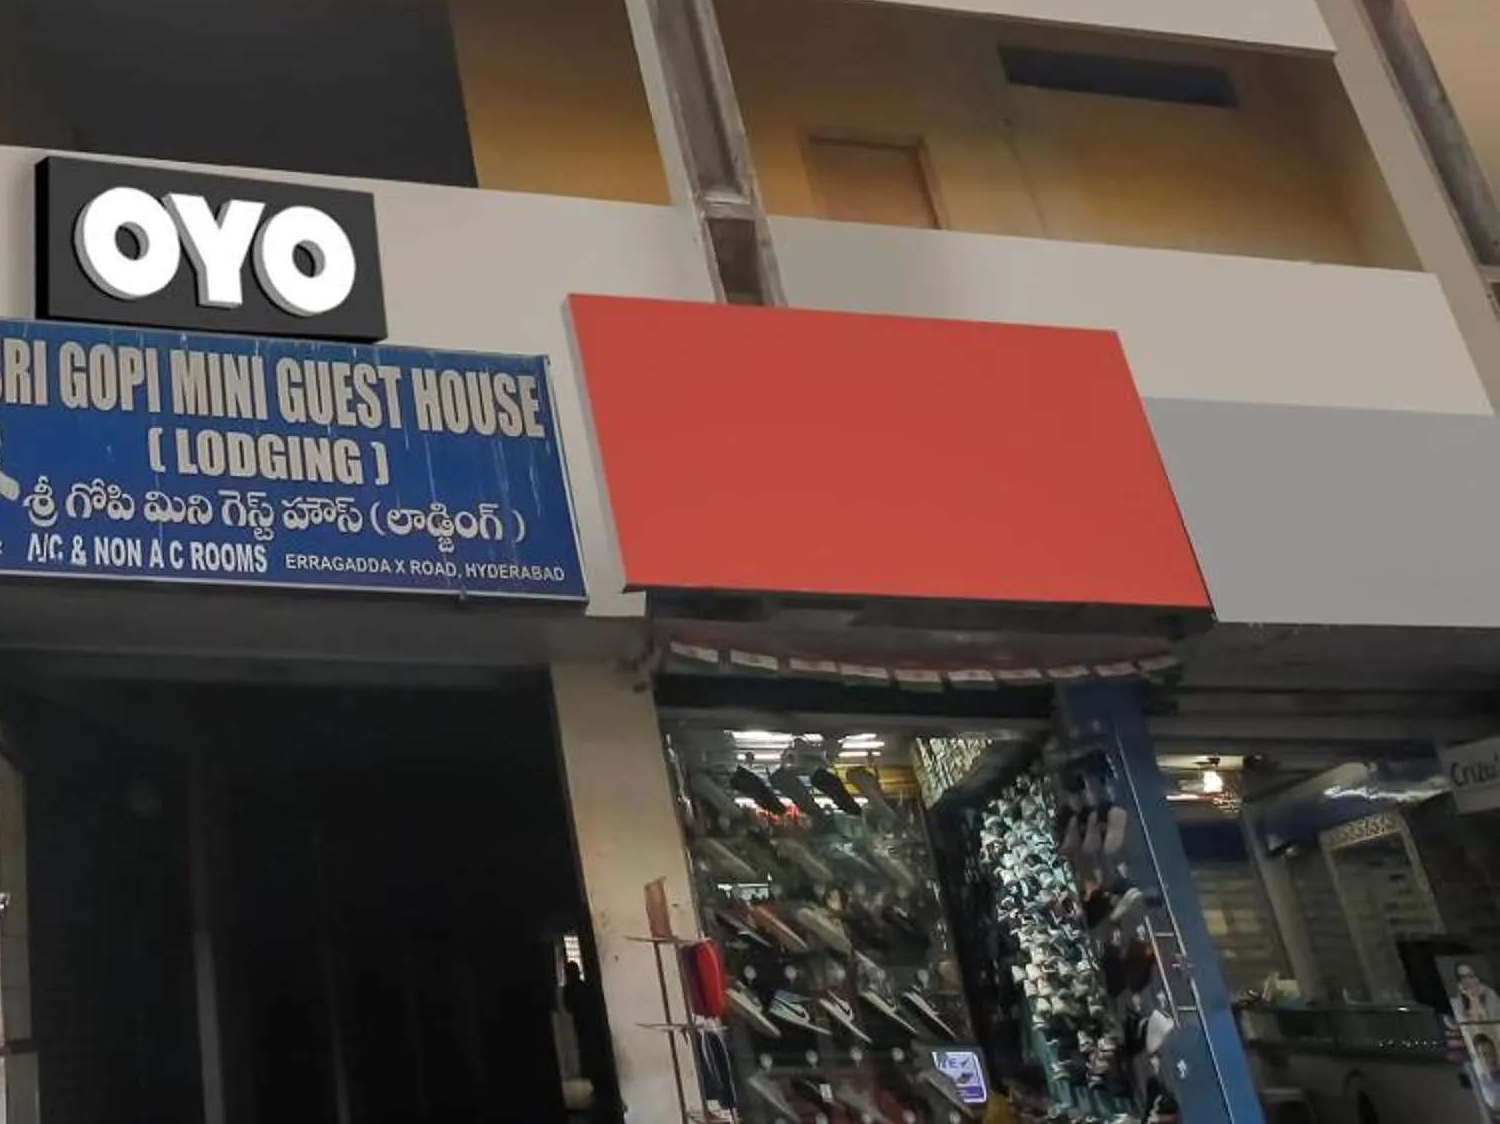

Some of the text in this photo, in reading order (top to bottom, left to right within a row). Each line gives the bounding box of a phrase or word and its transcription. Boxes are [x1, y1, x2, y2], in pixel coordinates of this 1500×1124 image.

[73, 186, 357, 317] OYO
[59, 340, 161, 414] GOPI
[170, 349, 269, 420] MINI
[276, 357, 402, 429] GUEST
[411, 367, 546, 438] HOUSE
[23, 475, 58, 528] శ్రీ
[65, 478, 135, 522] గోపి
[143, 489, 213, 526] మిని
[218, 489, 275, 541] గెస్ట్
[70, 534, 87, 566] &
[94, 536, 142, 567] NON
[191, 541, 267, 573] ROOMS
[285, 553, 391, 573] ERRAGADDA
[395, 560, 406, 574] X
[466, 563, 565, 581] HYDERABAD
